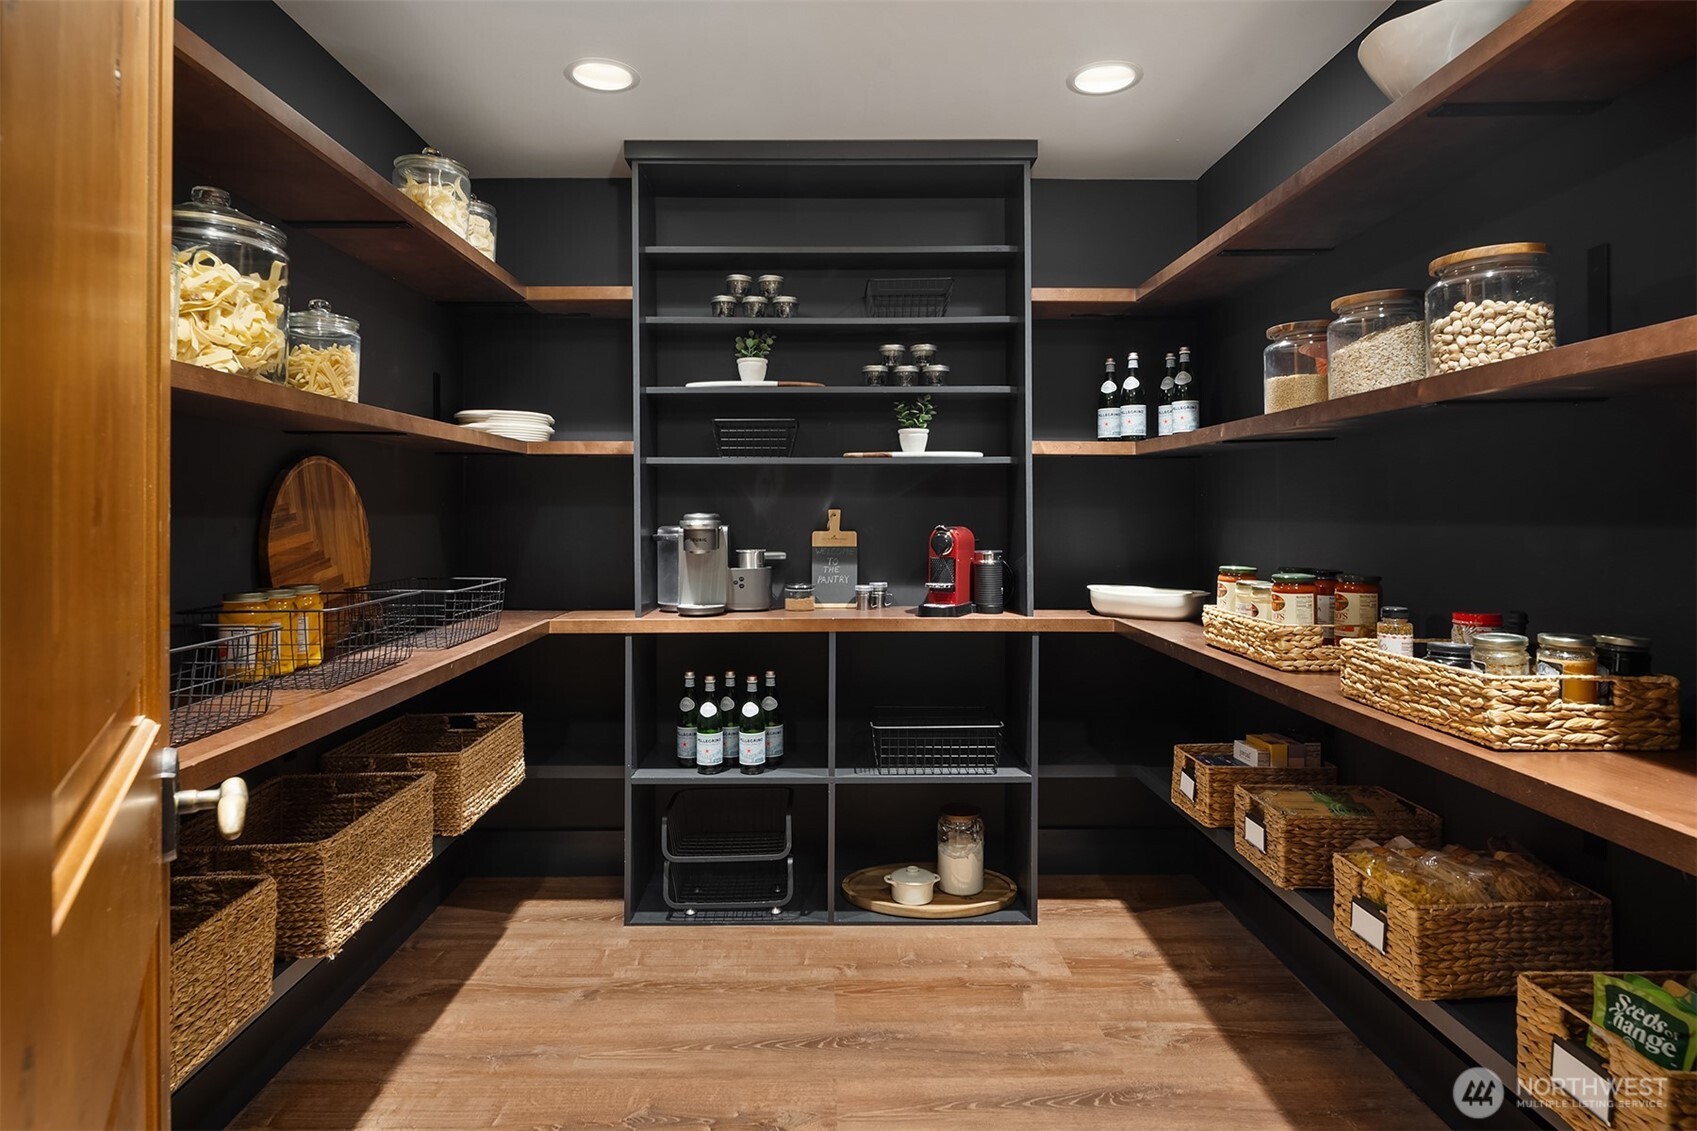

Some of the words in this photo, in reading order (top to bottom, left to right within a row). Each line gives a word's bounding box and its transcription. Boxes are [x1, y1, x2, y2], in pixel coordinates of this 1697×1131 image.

[828, 557, 838, 566] TO
[823, 565, 840, 573] THE
[817, 575, 850, 584] PANTRY
[1615, 993, 1668, 1033] Seeds
